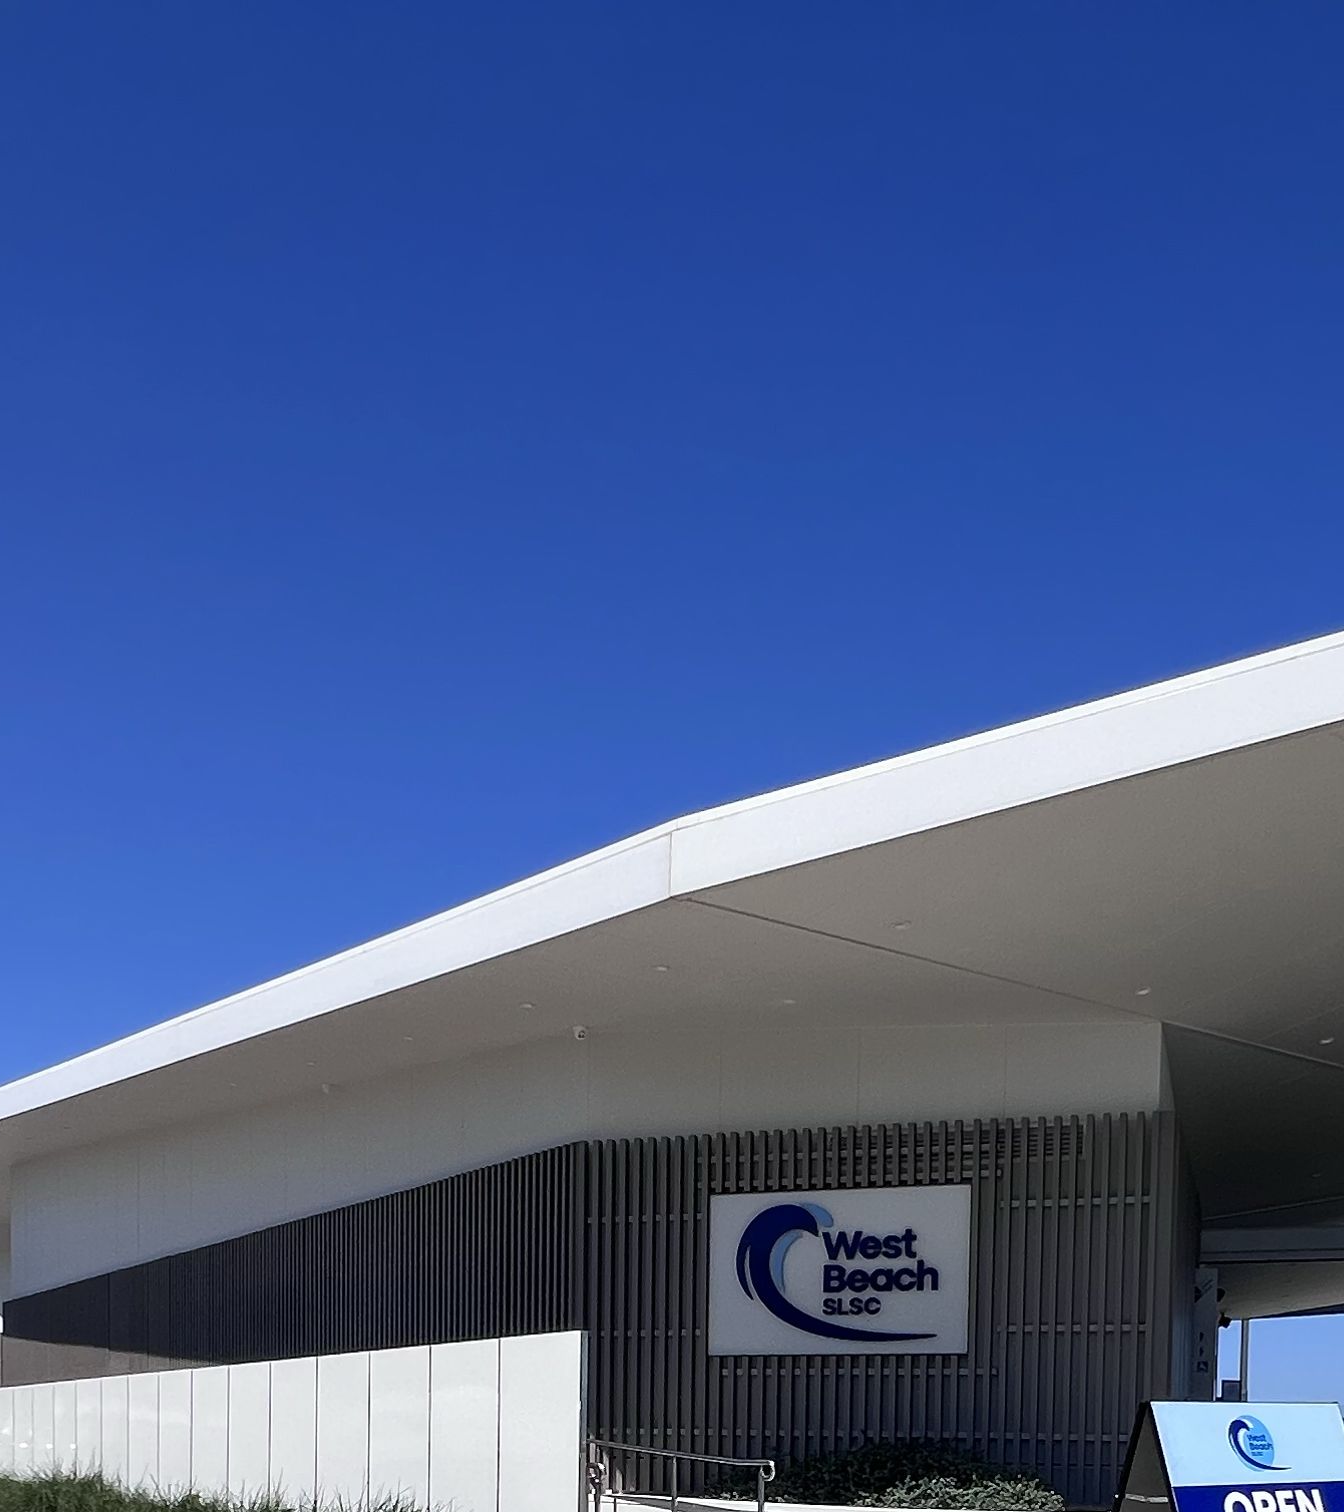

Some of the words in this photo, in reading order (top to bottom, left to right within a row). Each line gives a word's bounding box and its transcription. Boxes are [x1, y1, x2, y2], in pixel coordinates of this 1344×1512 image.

[822, 1228, 917, 1260] West
[823, 1259, 939, 1293] Beach
[822, 1297, 881, 1315] SLSC
